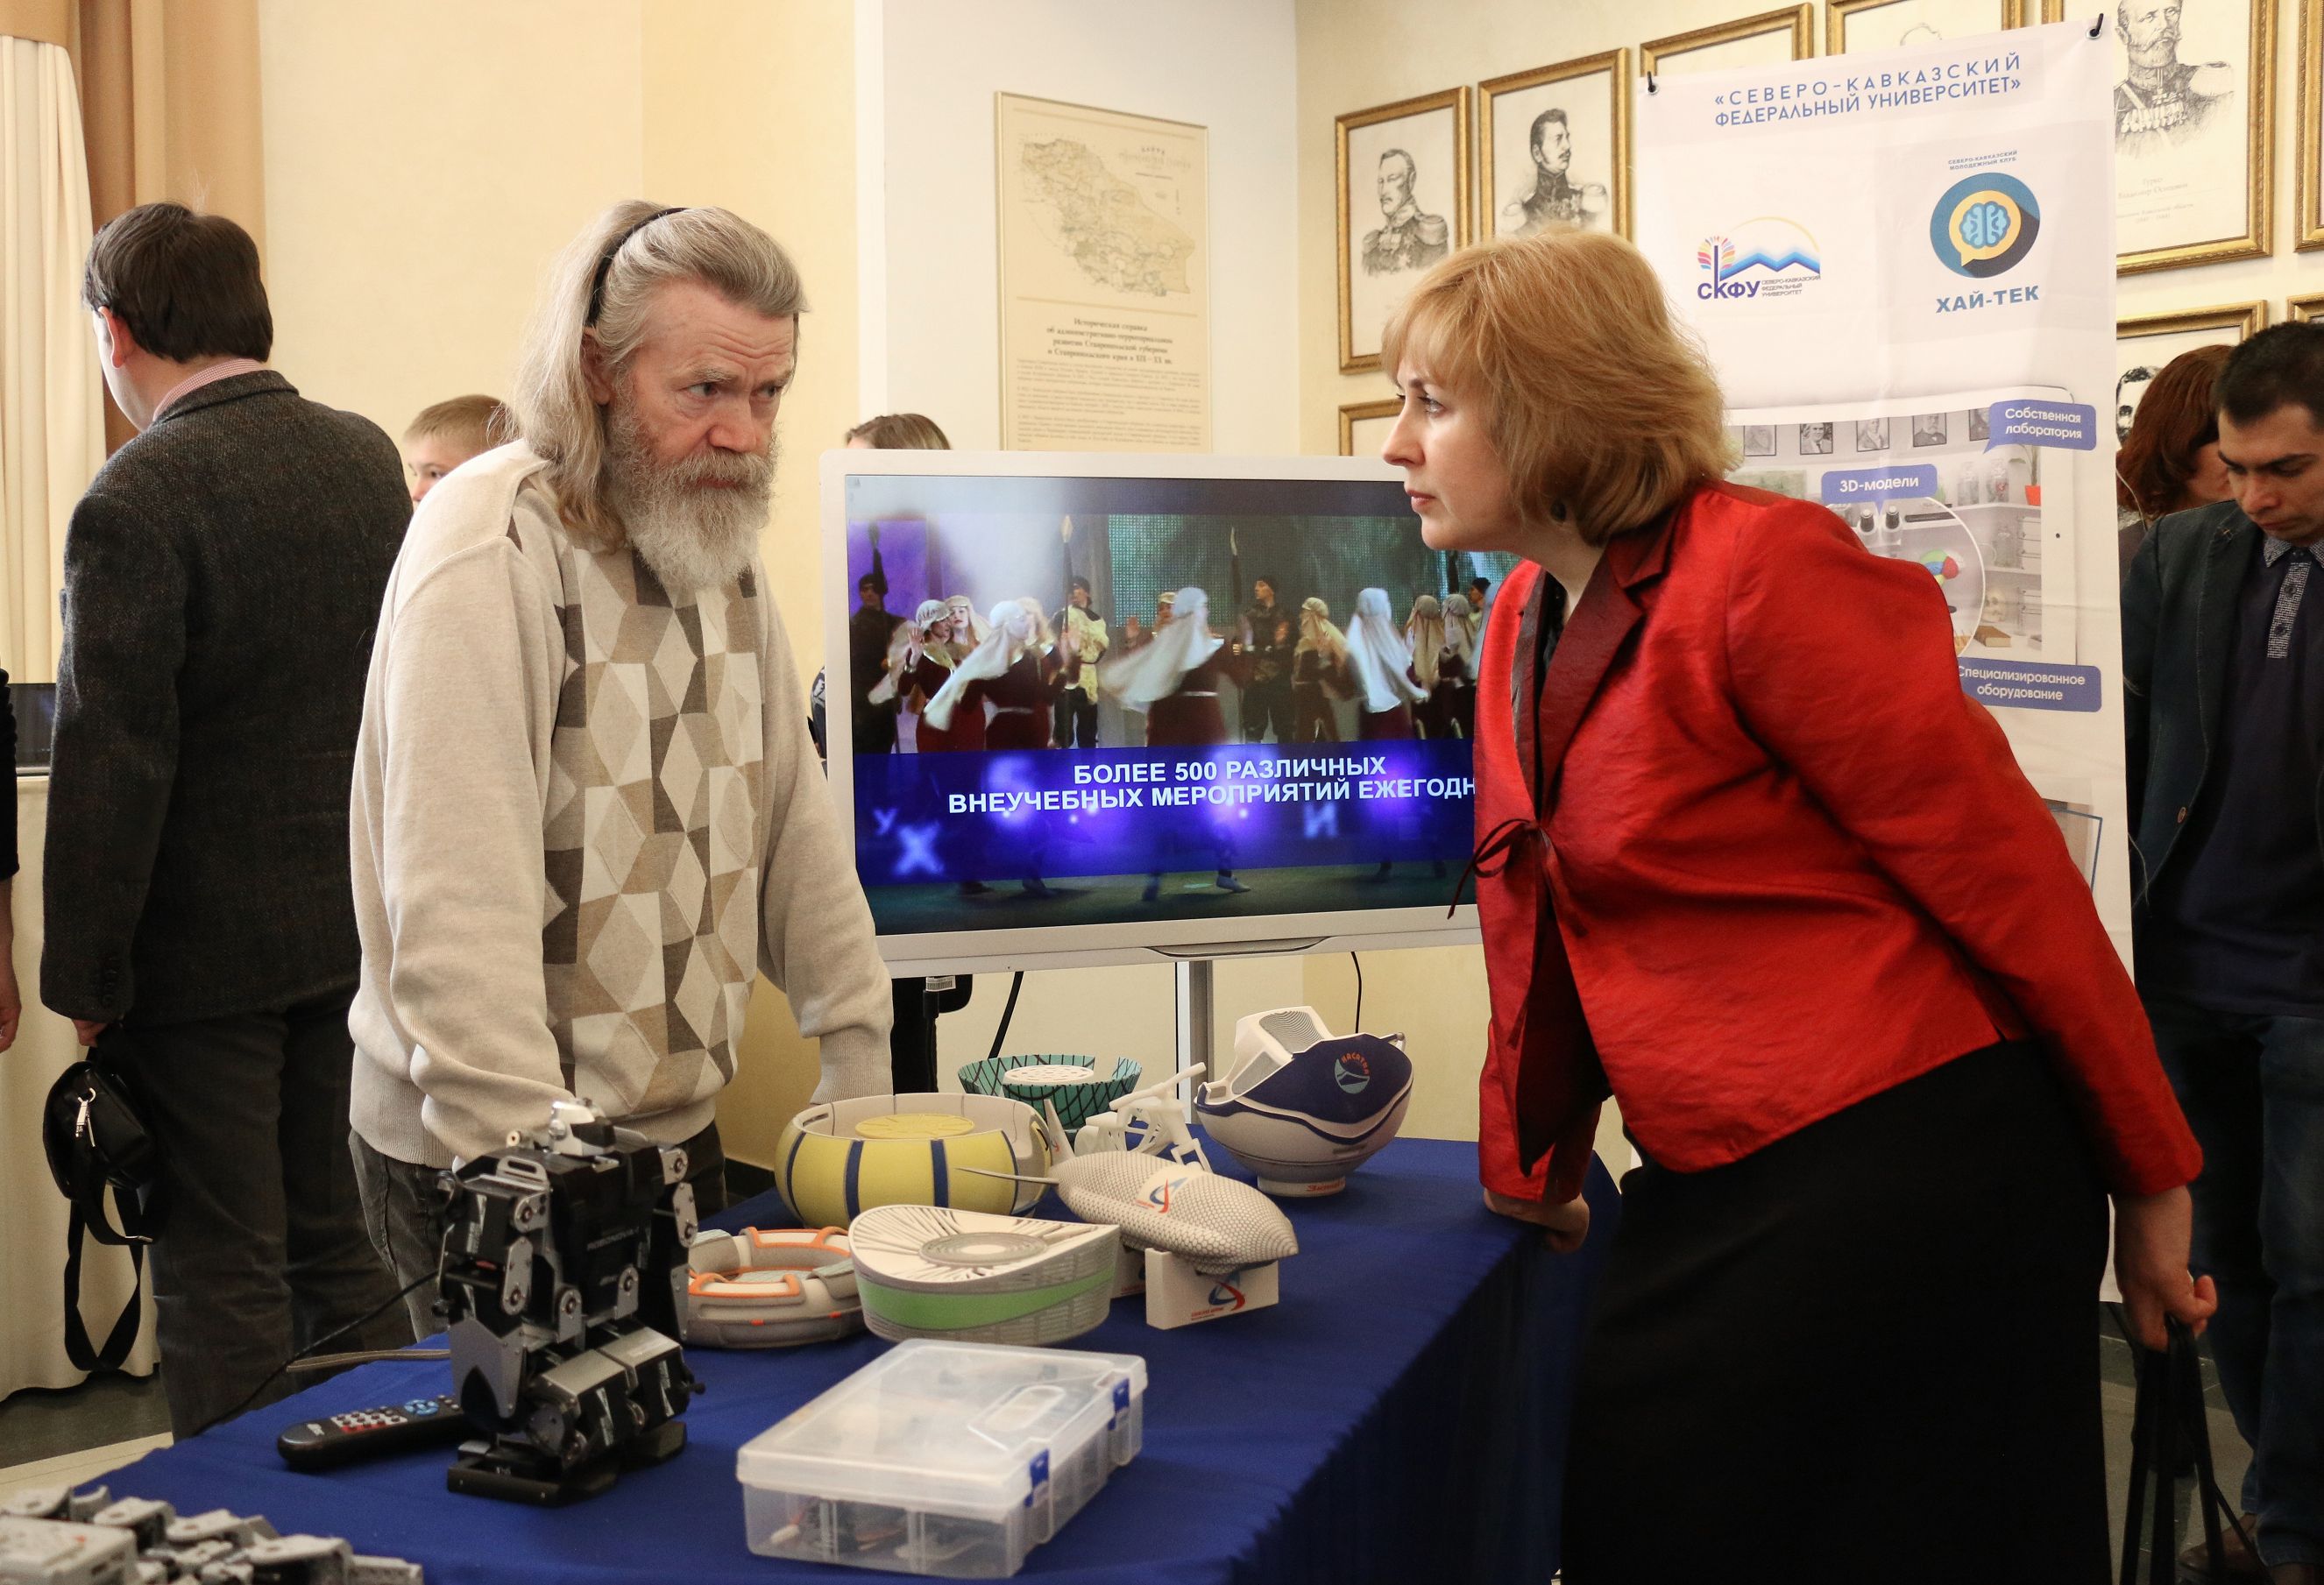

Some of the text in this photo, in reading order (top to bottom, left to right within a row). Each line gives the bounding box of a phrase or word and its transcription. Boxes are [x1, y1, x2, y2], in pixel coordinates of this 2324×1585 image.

[1715, 52, 2020, 105] «СЕВЕРО-КАВКАЗСКИЙ
[1715, 76, 2021, 126] ФЕДЕРАЛЬНЫЙ УНИВЕРСИТЕТ»
[1761, 274, 1822, 286] СЕВЕРО-КАВКАЗСКИЙ
[1761, 282, 1803, 292] ФЕДЕРАЛЬНЫЙ
[1761, 289, 1803, 298] УНИВЕРСИТЕТ
[1936, 285, 2039, 314] ХАЙ-ТЕК
[2005, 407, 2081, 423] Собственная
[2005, 422, 2082, 439] лаборатория
[1839, 478, 1919, 492] 3D-модели
[1959, 665, 2086, 685] Специализированное
[1977, 683, 2064, 700] оборудование
[1073, 756, 1387, 785] БОЛЕЕ 500 РАЗЛИЧНЫХ
[949, 777, 1476, 814] ВНЕУЧЕБНЫХ МЕРОПРИЯТИЙ ЕЖЕГОДН
